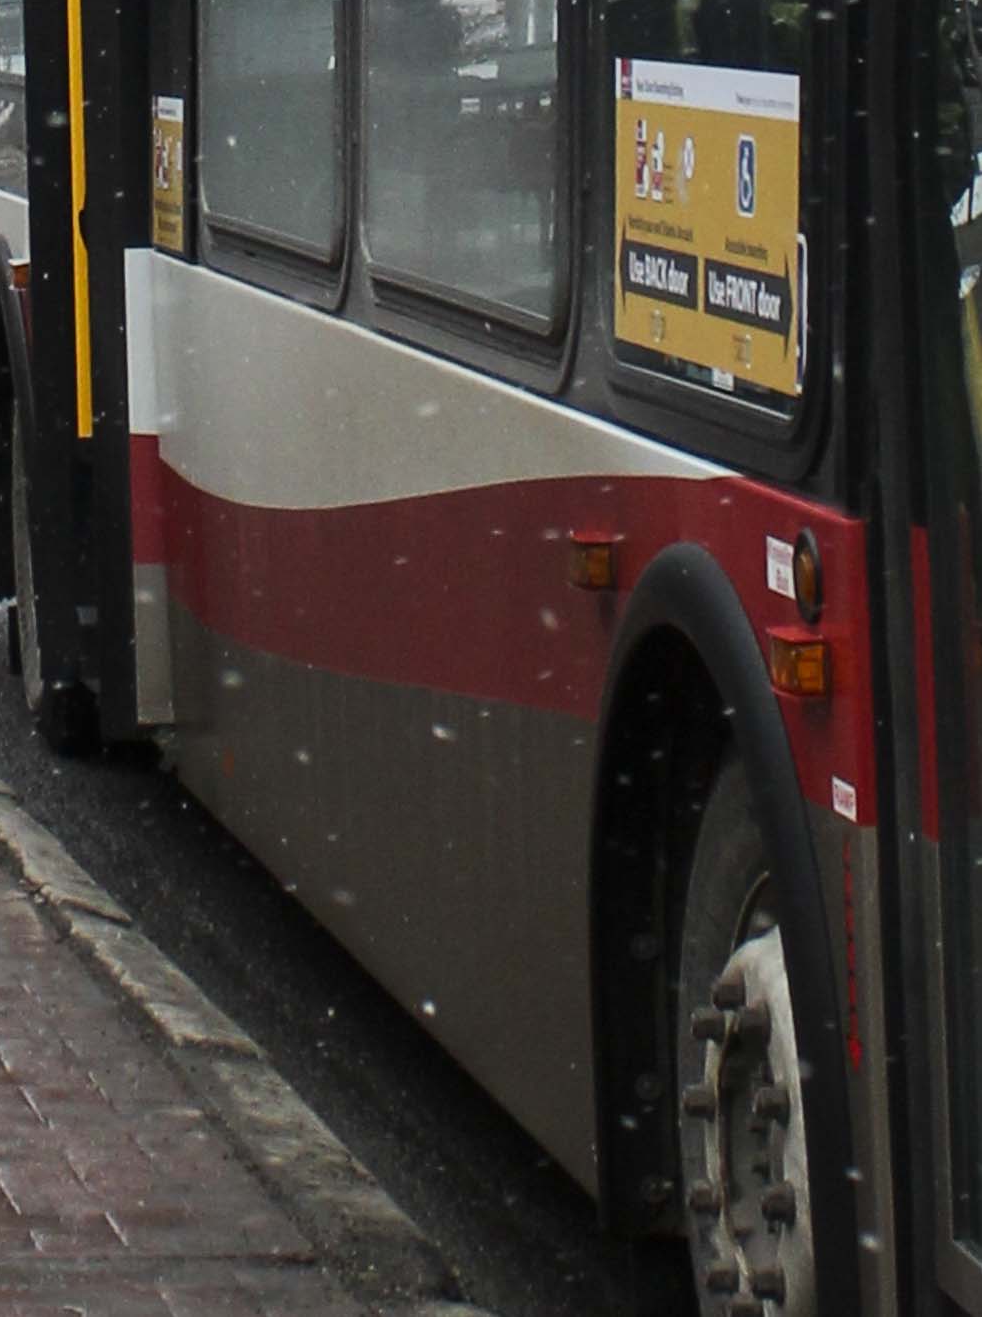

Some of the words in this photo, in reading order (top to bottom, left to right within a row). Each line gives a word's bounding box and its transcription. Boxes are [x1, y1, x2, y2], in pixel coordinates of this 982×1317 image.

[629, 251, 645, 285] Use
[645, 253, 668, 290] BACK
[668, 259, 689, 298] door
[708, 270, 726, 307] Use
[726, 274, 757, 315] FRONT
[758, 282, 781, 322] door
